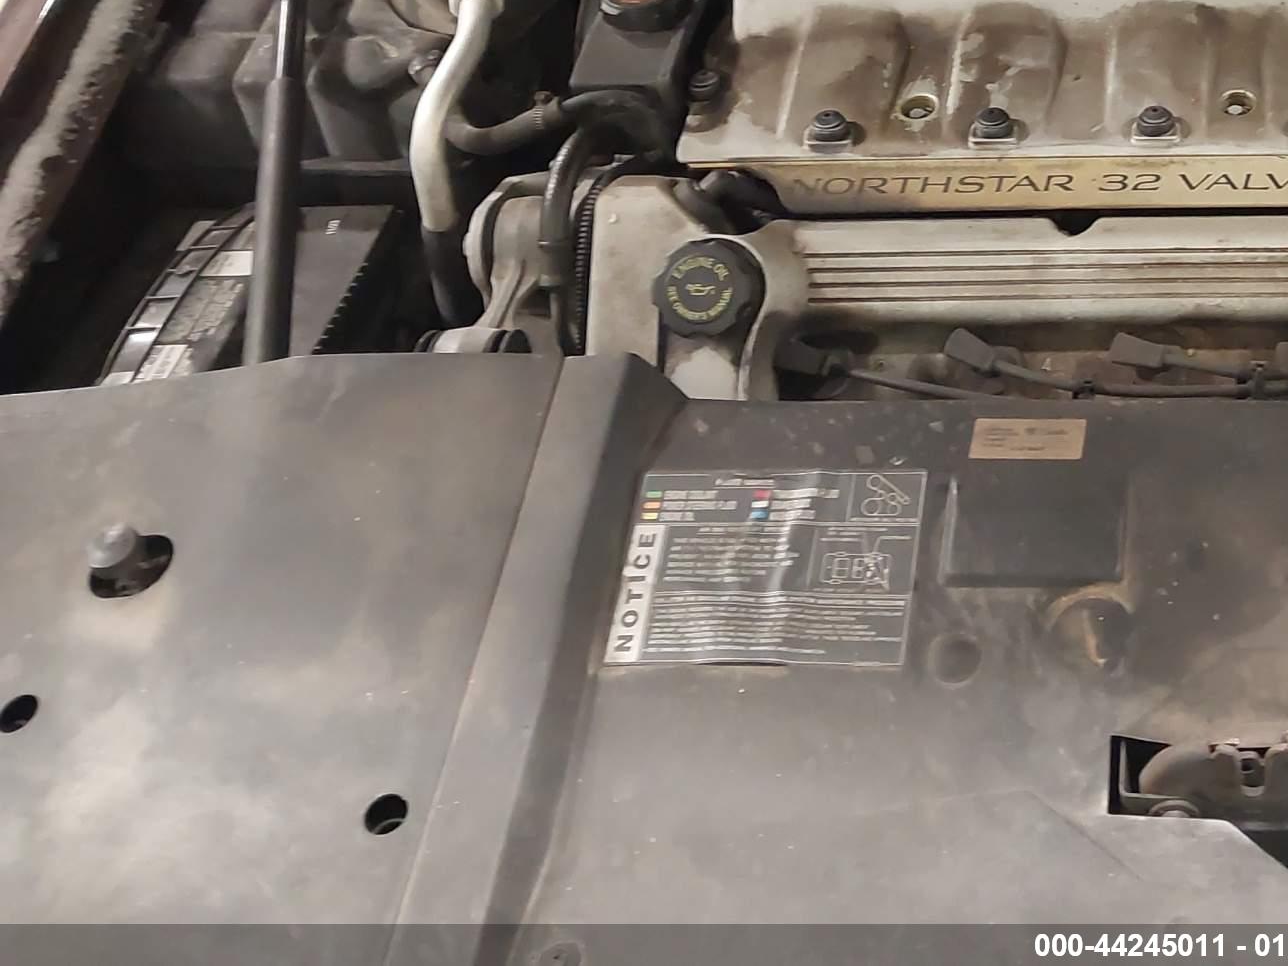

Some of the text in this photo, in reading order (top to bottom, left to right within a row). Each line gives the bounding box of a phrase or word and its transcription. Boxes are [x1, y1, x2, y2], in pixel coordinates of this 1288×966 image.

[790, 174, 1075, 195] NORTHSTAR
[1098, 173, 1161, 192] 32
[613, 532, 657, 654] NOTICE
